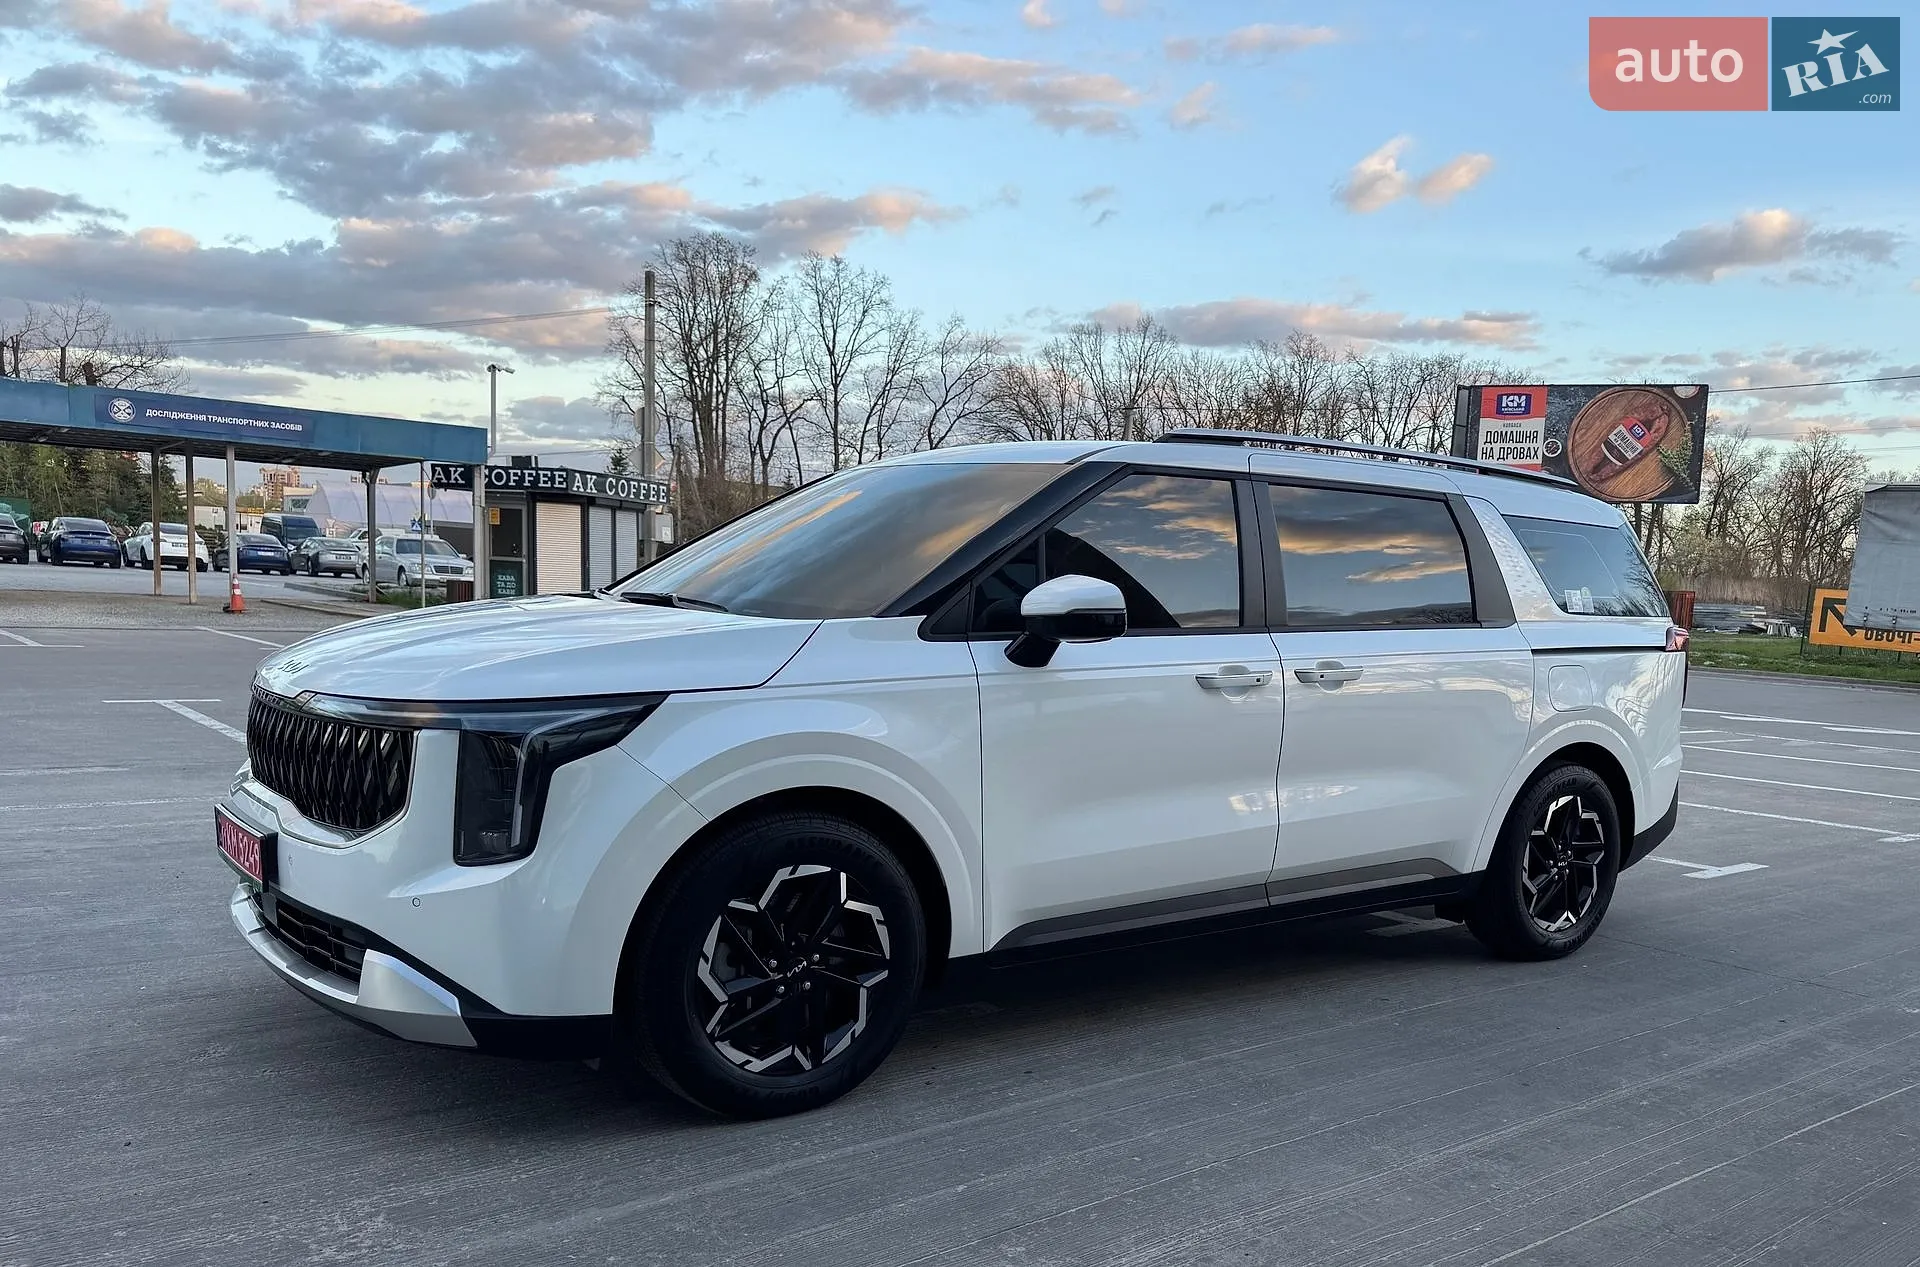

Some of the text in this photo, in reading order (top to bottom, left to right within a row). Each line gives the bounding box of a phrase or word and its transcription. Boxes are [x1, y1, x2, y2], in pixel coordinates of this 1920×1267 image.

[145, 408, 303, 432] ДОСЛІДЖЕННЯ ТРАНСПОРТНИХ ЗАСОБІВ
[1484, 430, 1539, 446] ДОМАШНЯ
[1481, 446, 1540, 462] НА ДРОВАХ
[432, 466, 466, 484] AK
[572, 472, 667, 503] AK COFFEE
[239, 832, 260, 875] 5249
